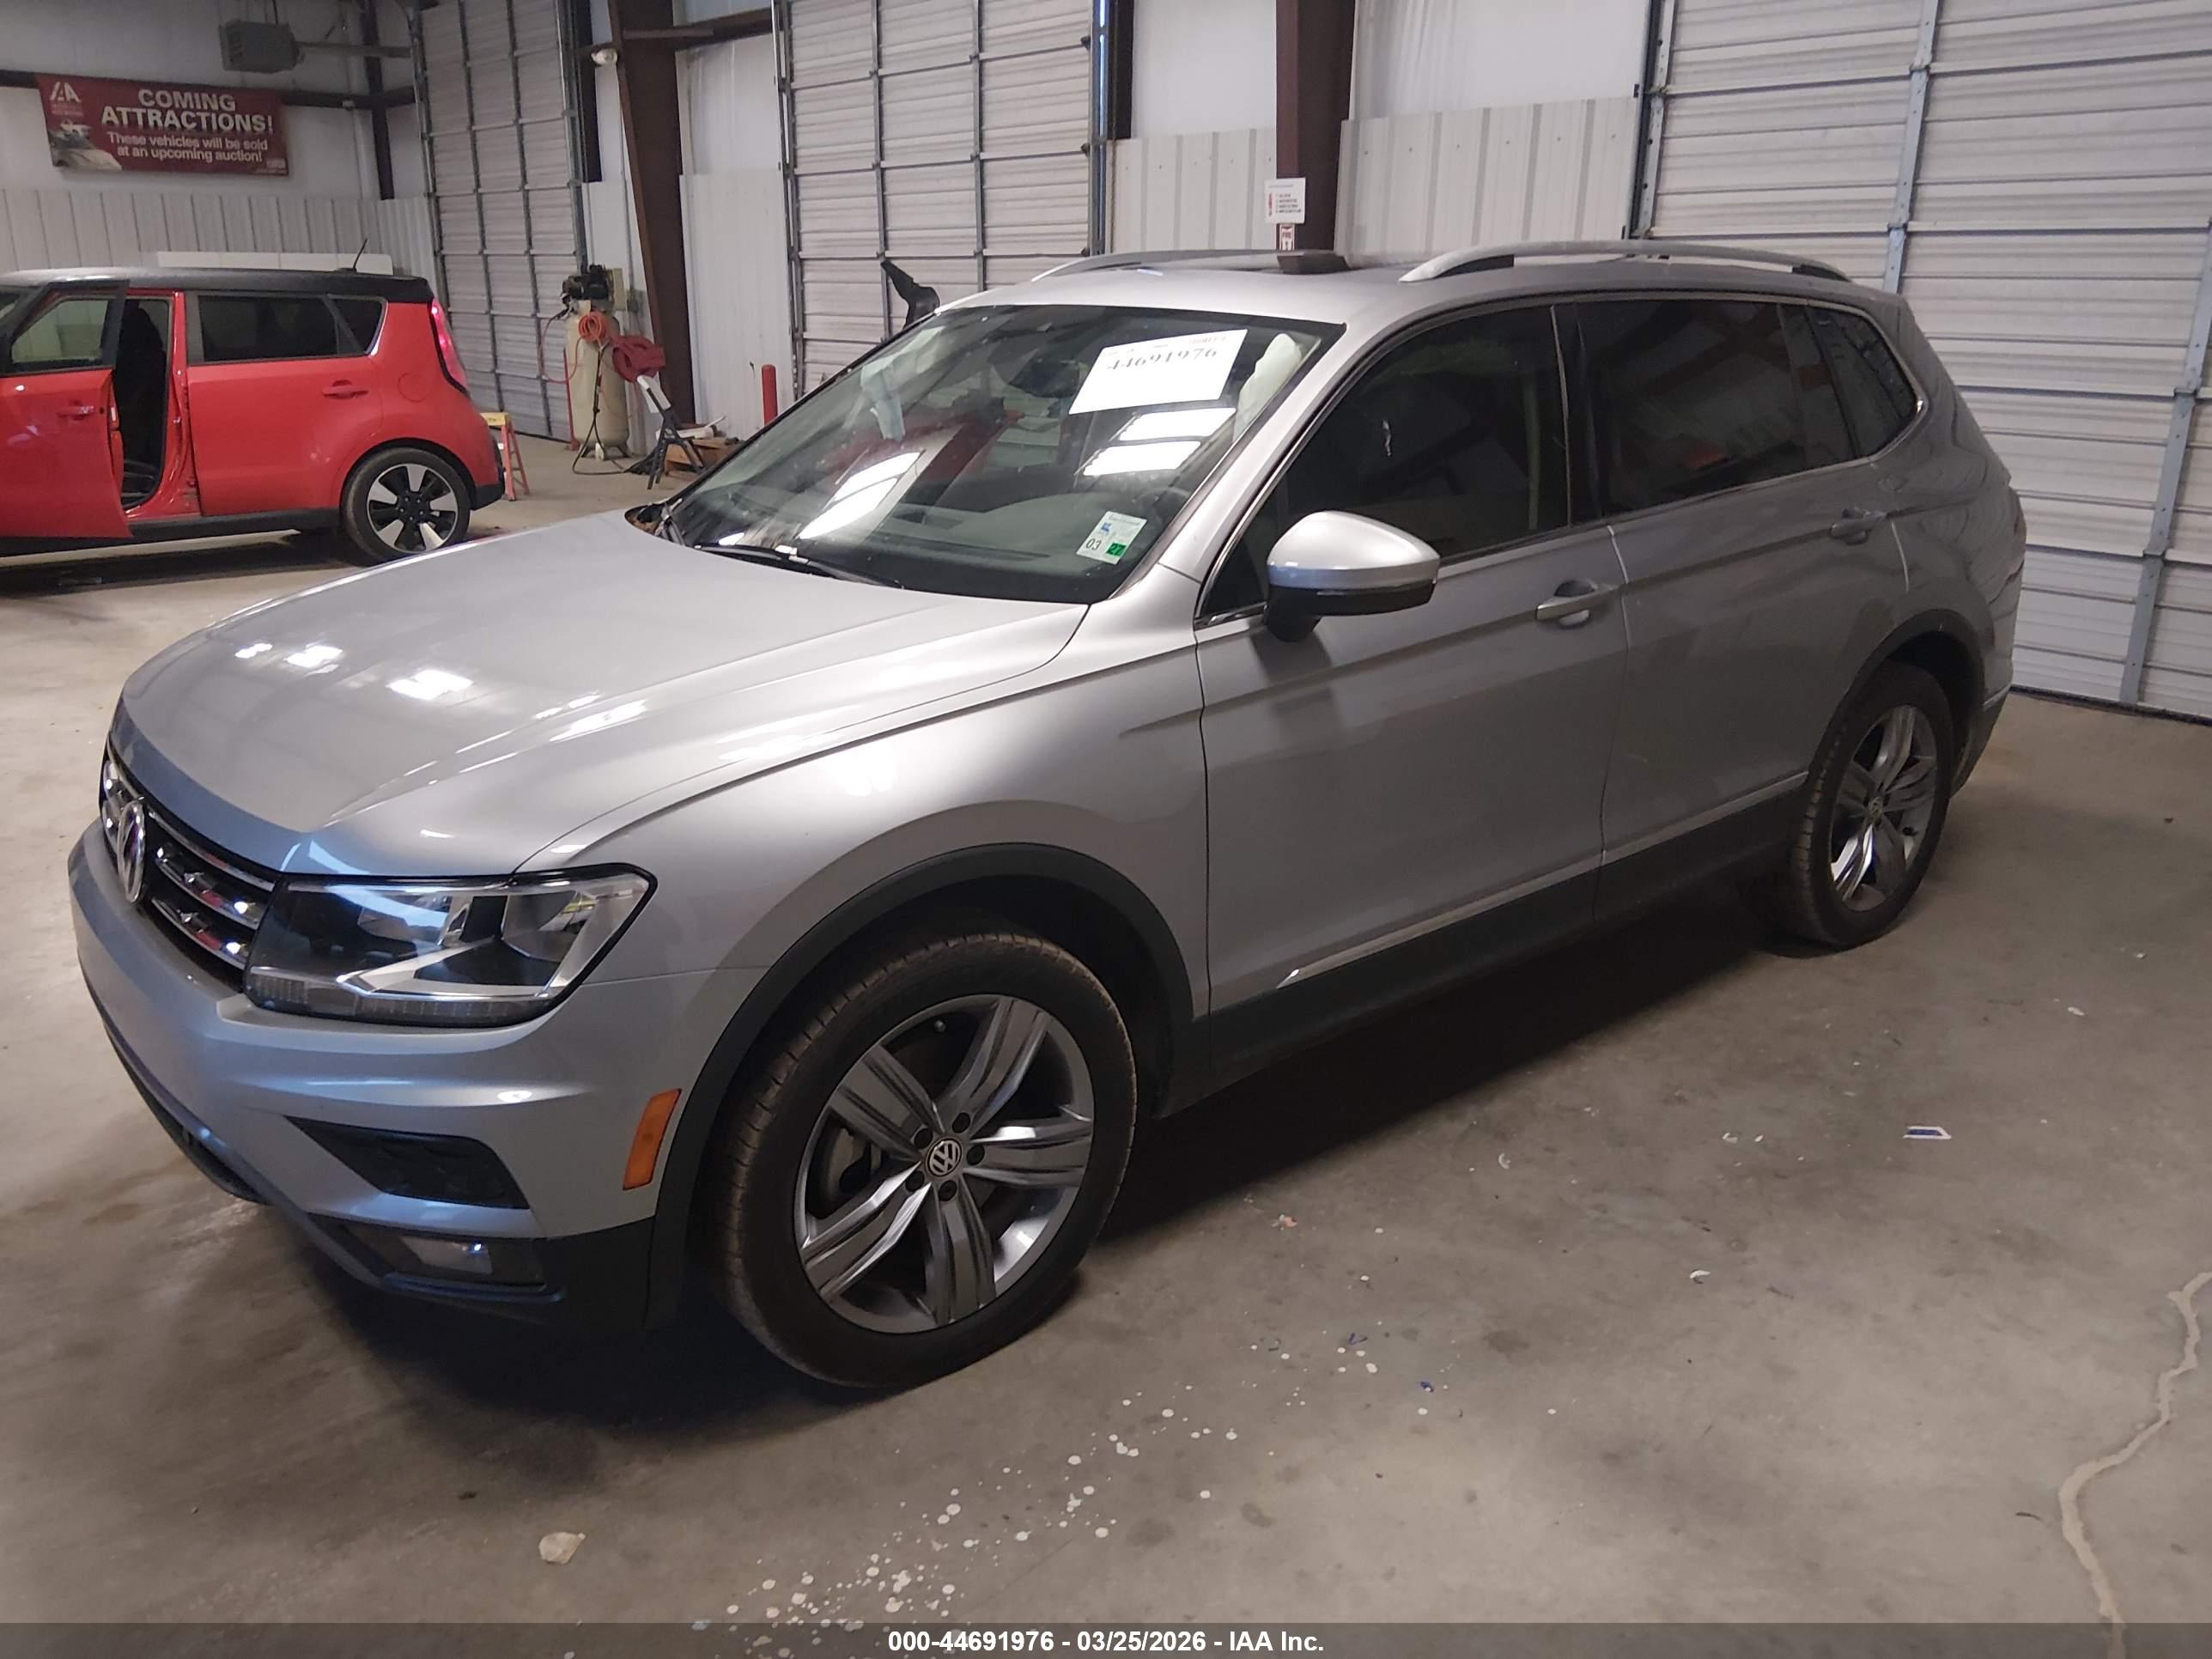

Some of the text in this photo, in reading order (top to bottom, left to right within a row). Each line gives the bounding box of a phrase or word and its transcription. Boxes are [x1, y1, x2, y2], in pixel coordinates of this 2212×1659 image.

[137, 88, 236, 112] COMING
[101, 106, 273, 134] ATTRACTIONS!
[106, 131, 268, 151] These vehicles will be sold
[117, 146, 262, 163] at an upcoming auction!
[1107, 348, 1217, 370] 44691976
[1085, 538, 1127, 556] 03 27
